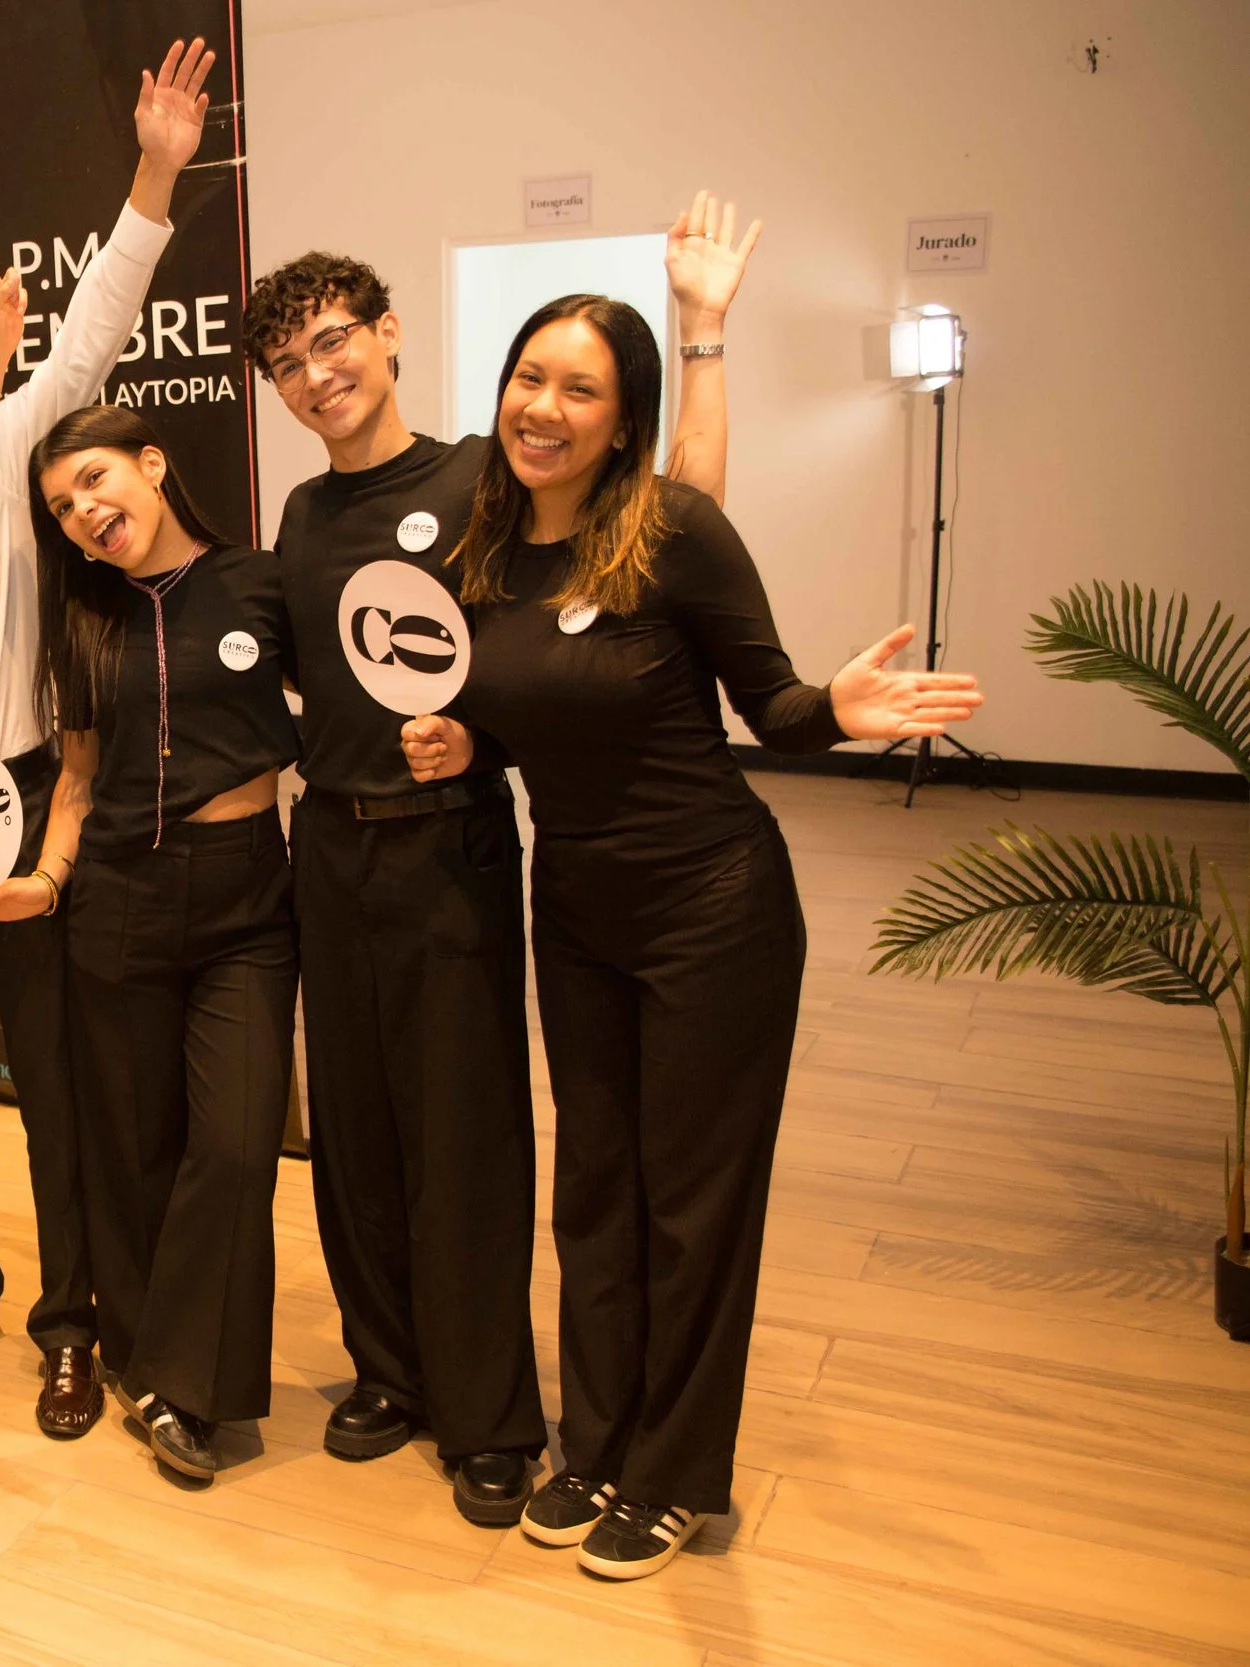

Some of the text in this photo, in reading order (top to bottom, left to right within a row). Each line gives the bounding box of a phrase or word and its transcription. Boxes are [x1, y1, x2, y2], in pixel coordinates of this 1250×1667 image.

[916, 232, 977, 250] Jurado
[223, 641, 258, 655] SURCO
[351, 606, 457, 675] CO
